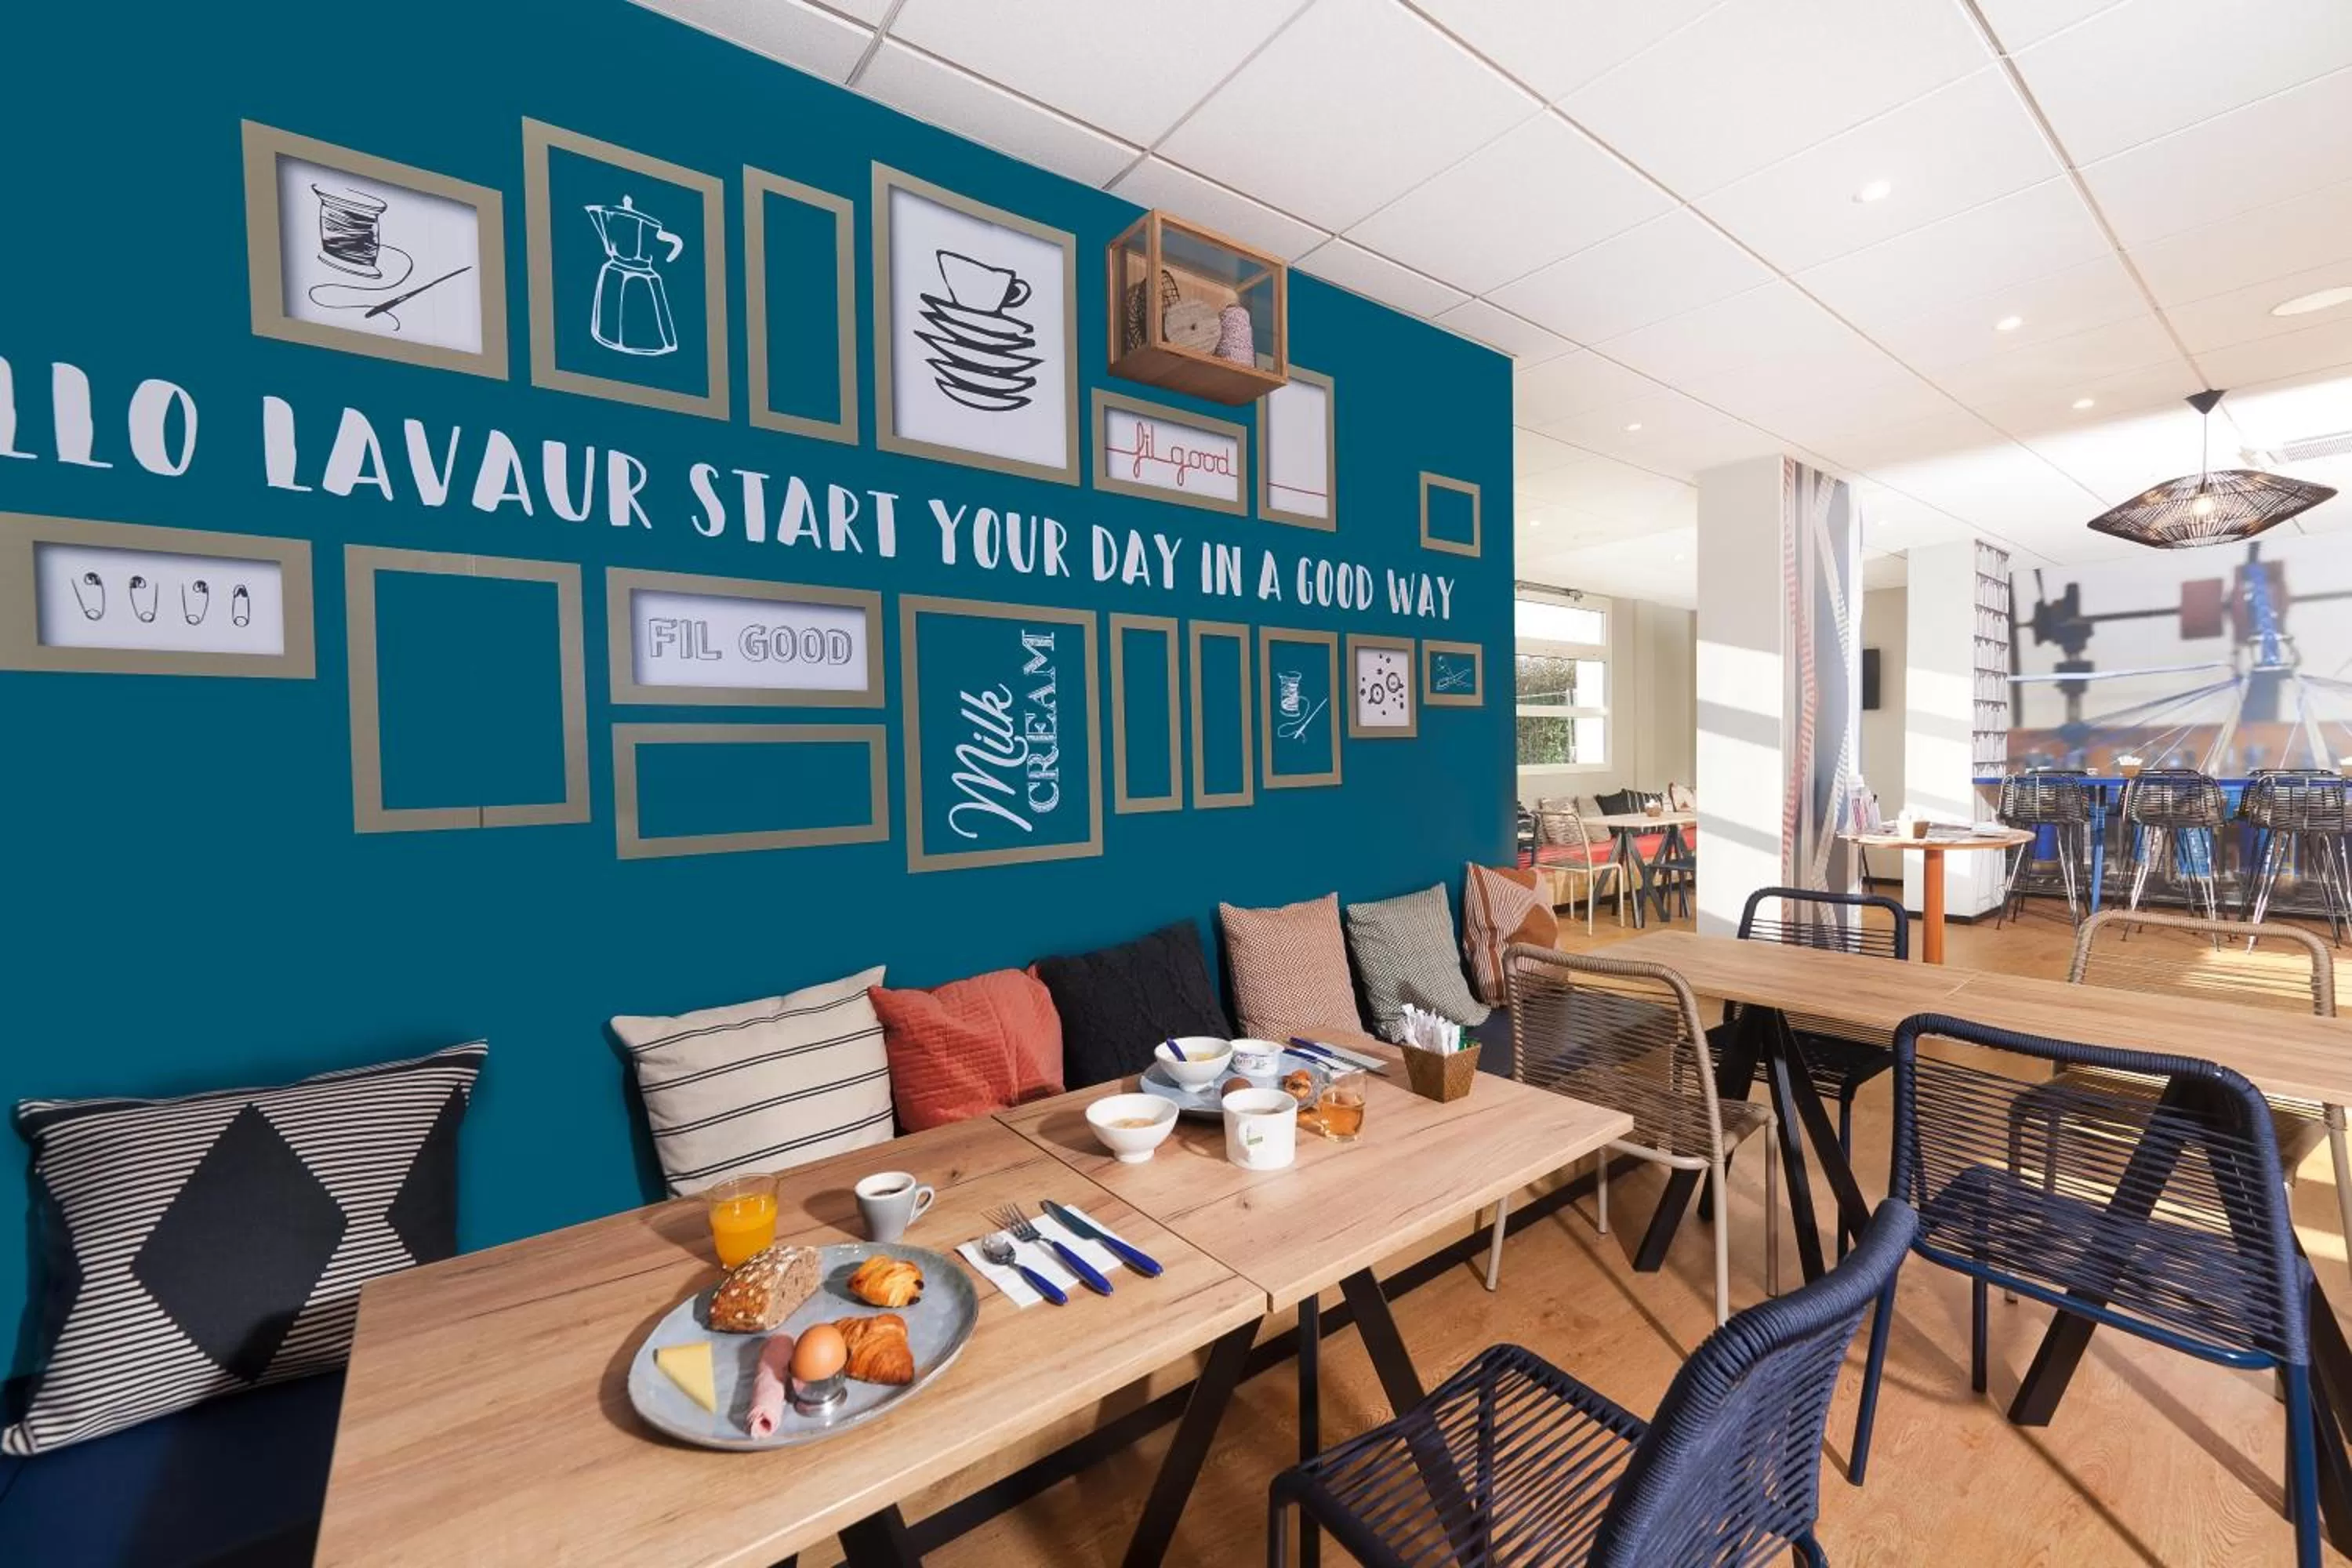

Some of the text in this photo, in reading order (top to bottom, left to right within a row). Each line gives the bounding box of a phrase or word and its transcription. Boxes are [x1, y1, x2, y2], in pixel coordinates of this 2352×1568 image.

[263, 395, 652, 529] LAVAUR
[689, 463, 899, 557] START
[927, 499, 1070, 578] YOUR
[1092, 524, 1181, 590] DAY
[1201, 542, 1242, 597] IN
[1258, 550, 1281, 601] A
[1297, 557, 1374, 611] GOOD
[1387, 569, 1455, 620] WAY
[1132, 421, 1232, 486] fil good
[648, 618, 853, 666] FIL GOOD
[948, 683, 1033, 838] Milk
[1022, 630, 1059, 813] CREAM
